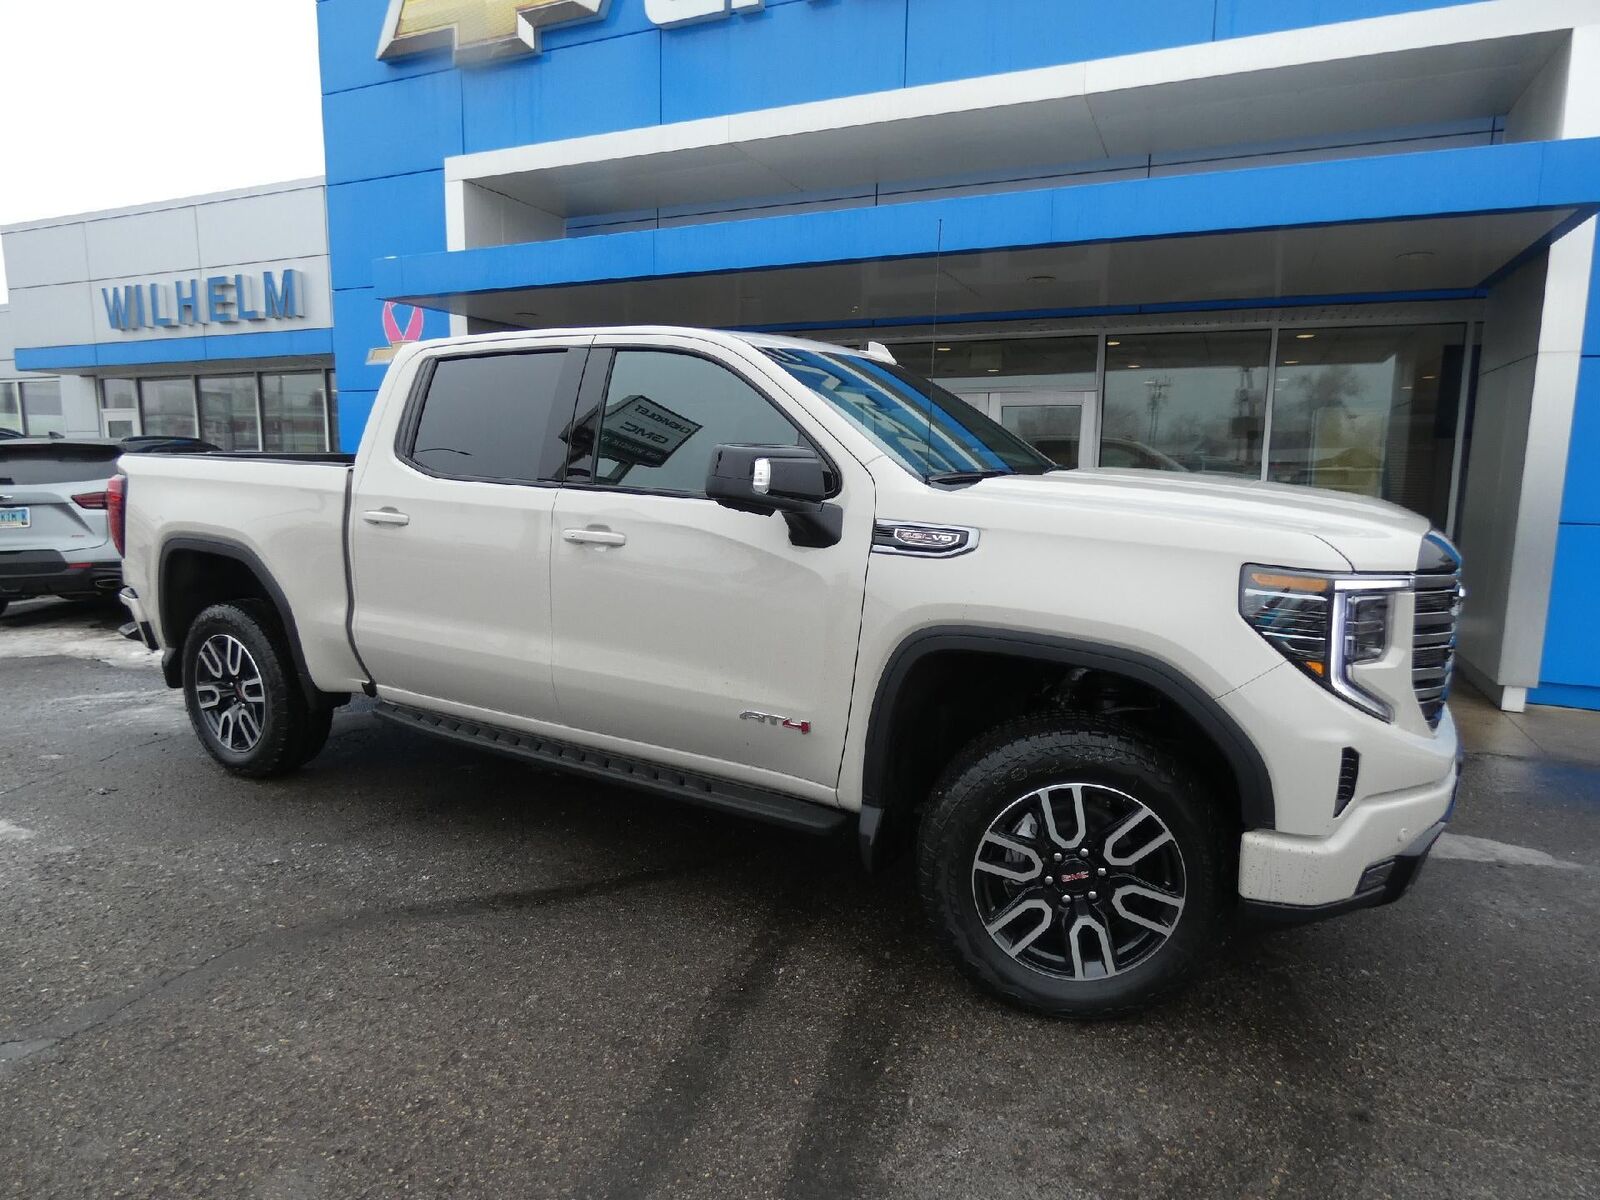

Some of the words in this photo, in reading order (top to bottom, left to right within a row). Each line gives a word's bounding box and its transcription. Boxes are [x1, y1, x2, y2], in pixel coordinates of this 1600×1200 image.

[101, 269, 301, 330] WILHELM
[739, 710, 811, 735] AT4
[1061, 870, 1089, 882] GMC
